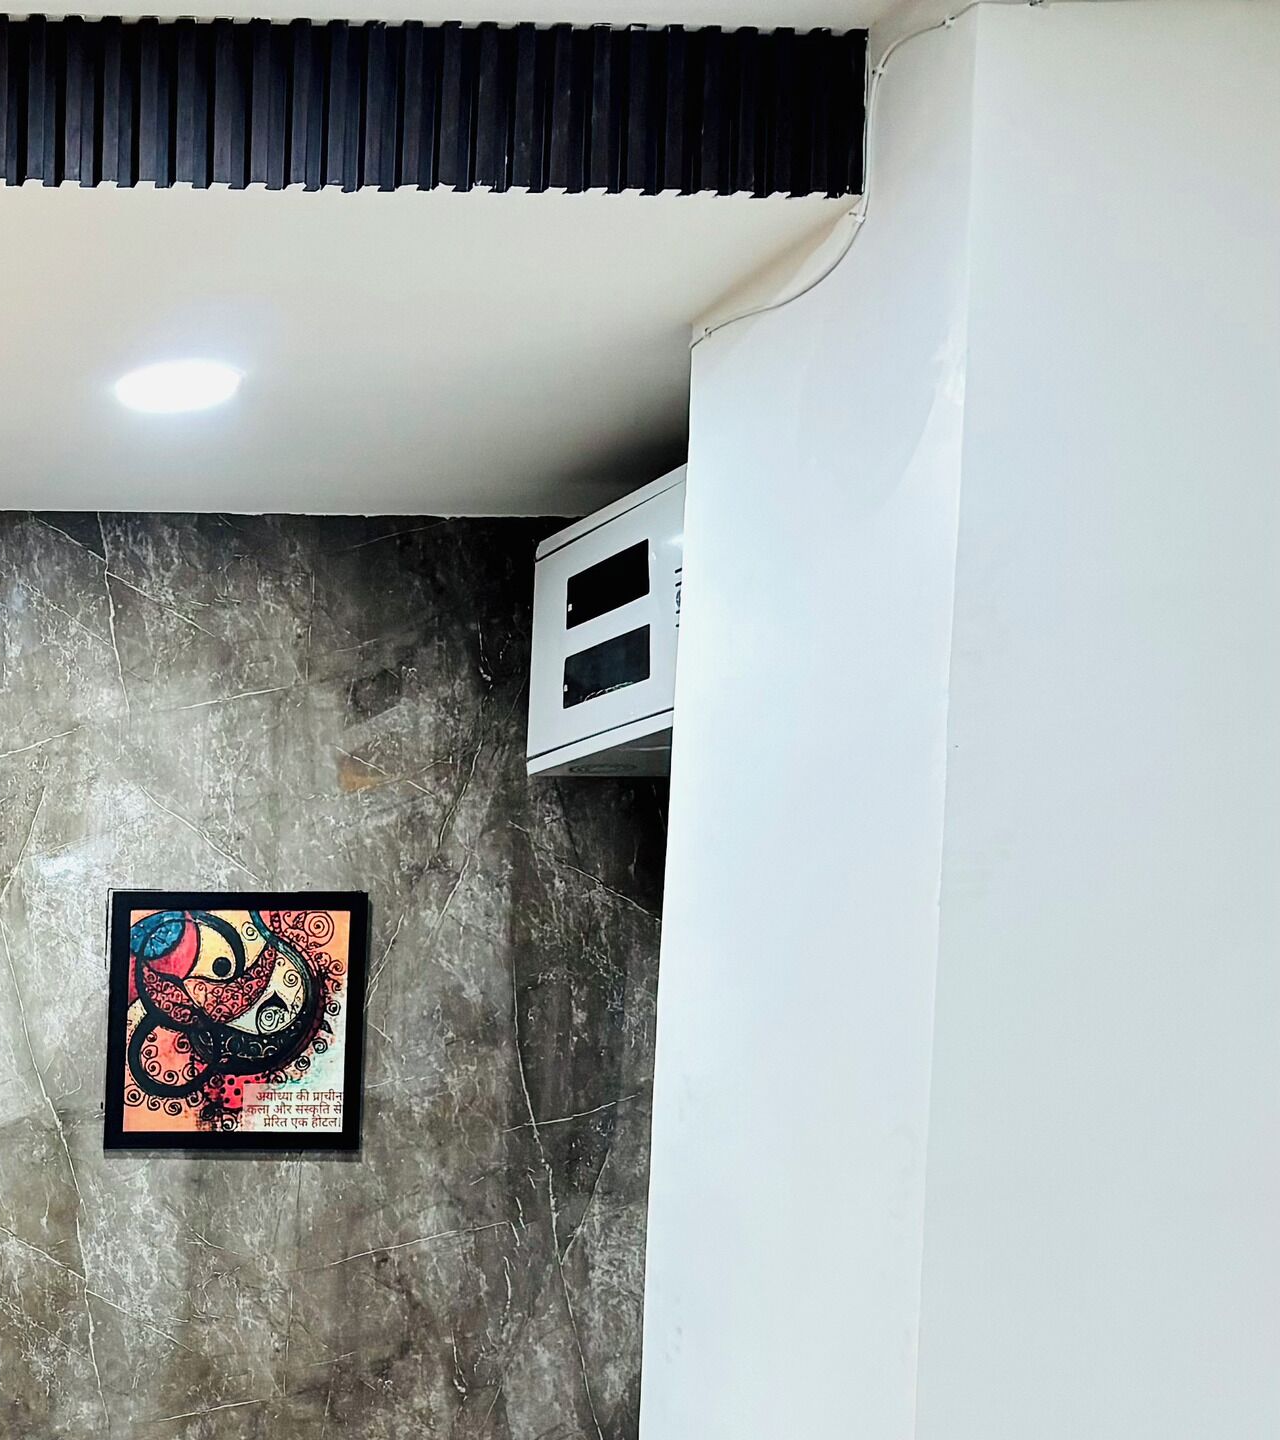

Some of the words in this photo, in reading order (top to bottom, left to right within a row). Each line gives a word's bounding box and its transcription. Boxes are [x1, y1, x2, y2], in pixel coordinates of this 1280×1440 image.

[296, 1089, 309, 1101] की
[313, 1089, 342, 1101] प्राचीन
[247, 1104, 269, 1114] कला
[273, 1102, 292, 1114] और
[333, 1101, 342, 1114] से
[263, 1115, 287, 1127] प्रेरित
[291, 1117, 308, 1128] एक
